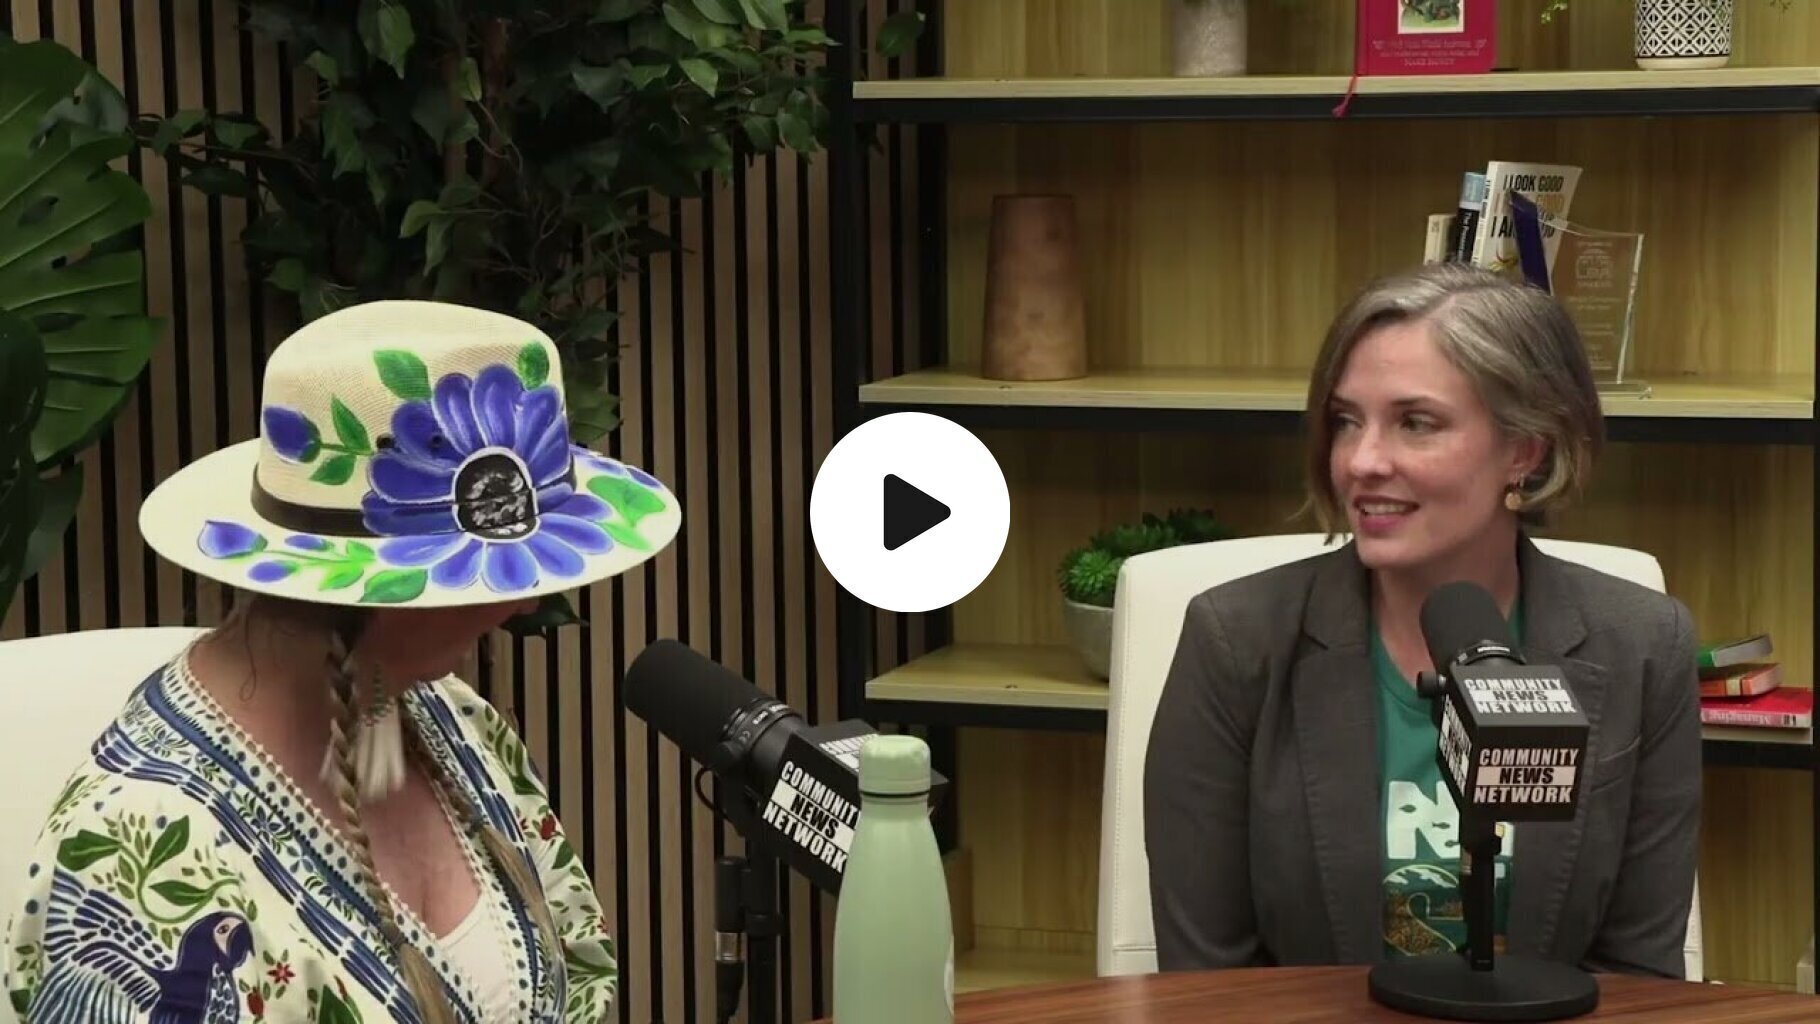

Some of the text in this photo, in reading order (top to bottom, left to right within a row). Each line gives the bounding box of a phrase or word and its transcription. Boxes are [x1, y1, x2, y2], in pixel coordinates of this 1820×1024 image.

[1464, 678, 1562, 690] COMMUNITY
[1492, 690, 1548, 701] NEWS
[1474, 701, 1577, 713] NETWORK
[1479, 748, 1580, 766] COMMUNITY
[1499, 767, 1555, 785] NEWS
[781, 760, 861, 829] COMMUNIT
[1473, 786, 1573, 803] NETWORK
[790, 792, 841, 839] NEWS
[762, 800, 849, 874] NETWORK
